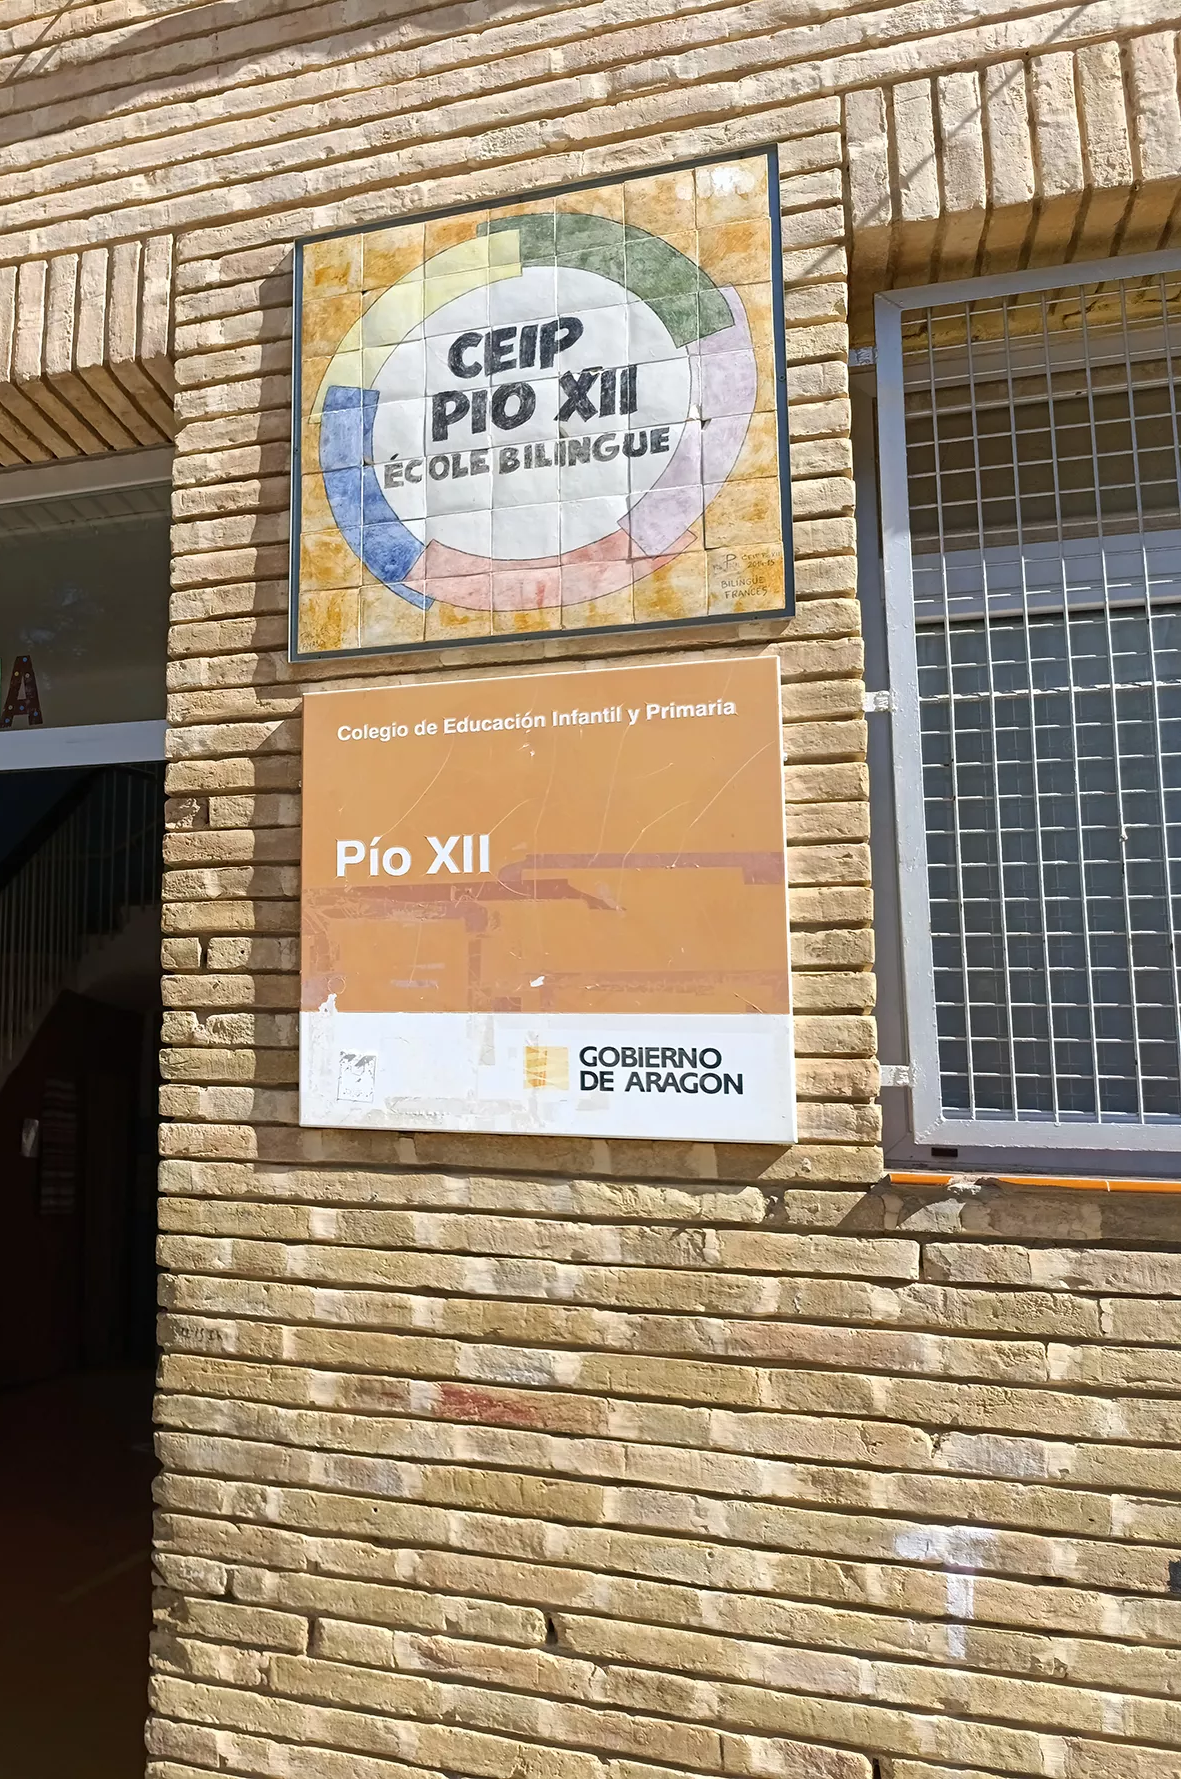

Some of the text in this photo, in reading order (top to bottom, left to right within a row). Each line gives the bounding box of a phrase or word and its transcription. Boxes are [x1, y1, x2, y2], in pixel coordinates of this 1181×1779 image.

[447, 316, 584, 379] CEIP
[432, 364, 638, 442] PIO XII
[384, 426, 670, 489] ÉCOLE BILINGUE
[337, 699, 736, 742] Colegio de Educación Infantil y Primaria
[336, 834, 490, 876] Pío XII
[579, 1046, 722, 1069] GOBIERNO
[580, 1070, 743, 1094] DE ARAGON
